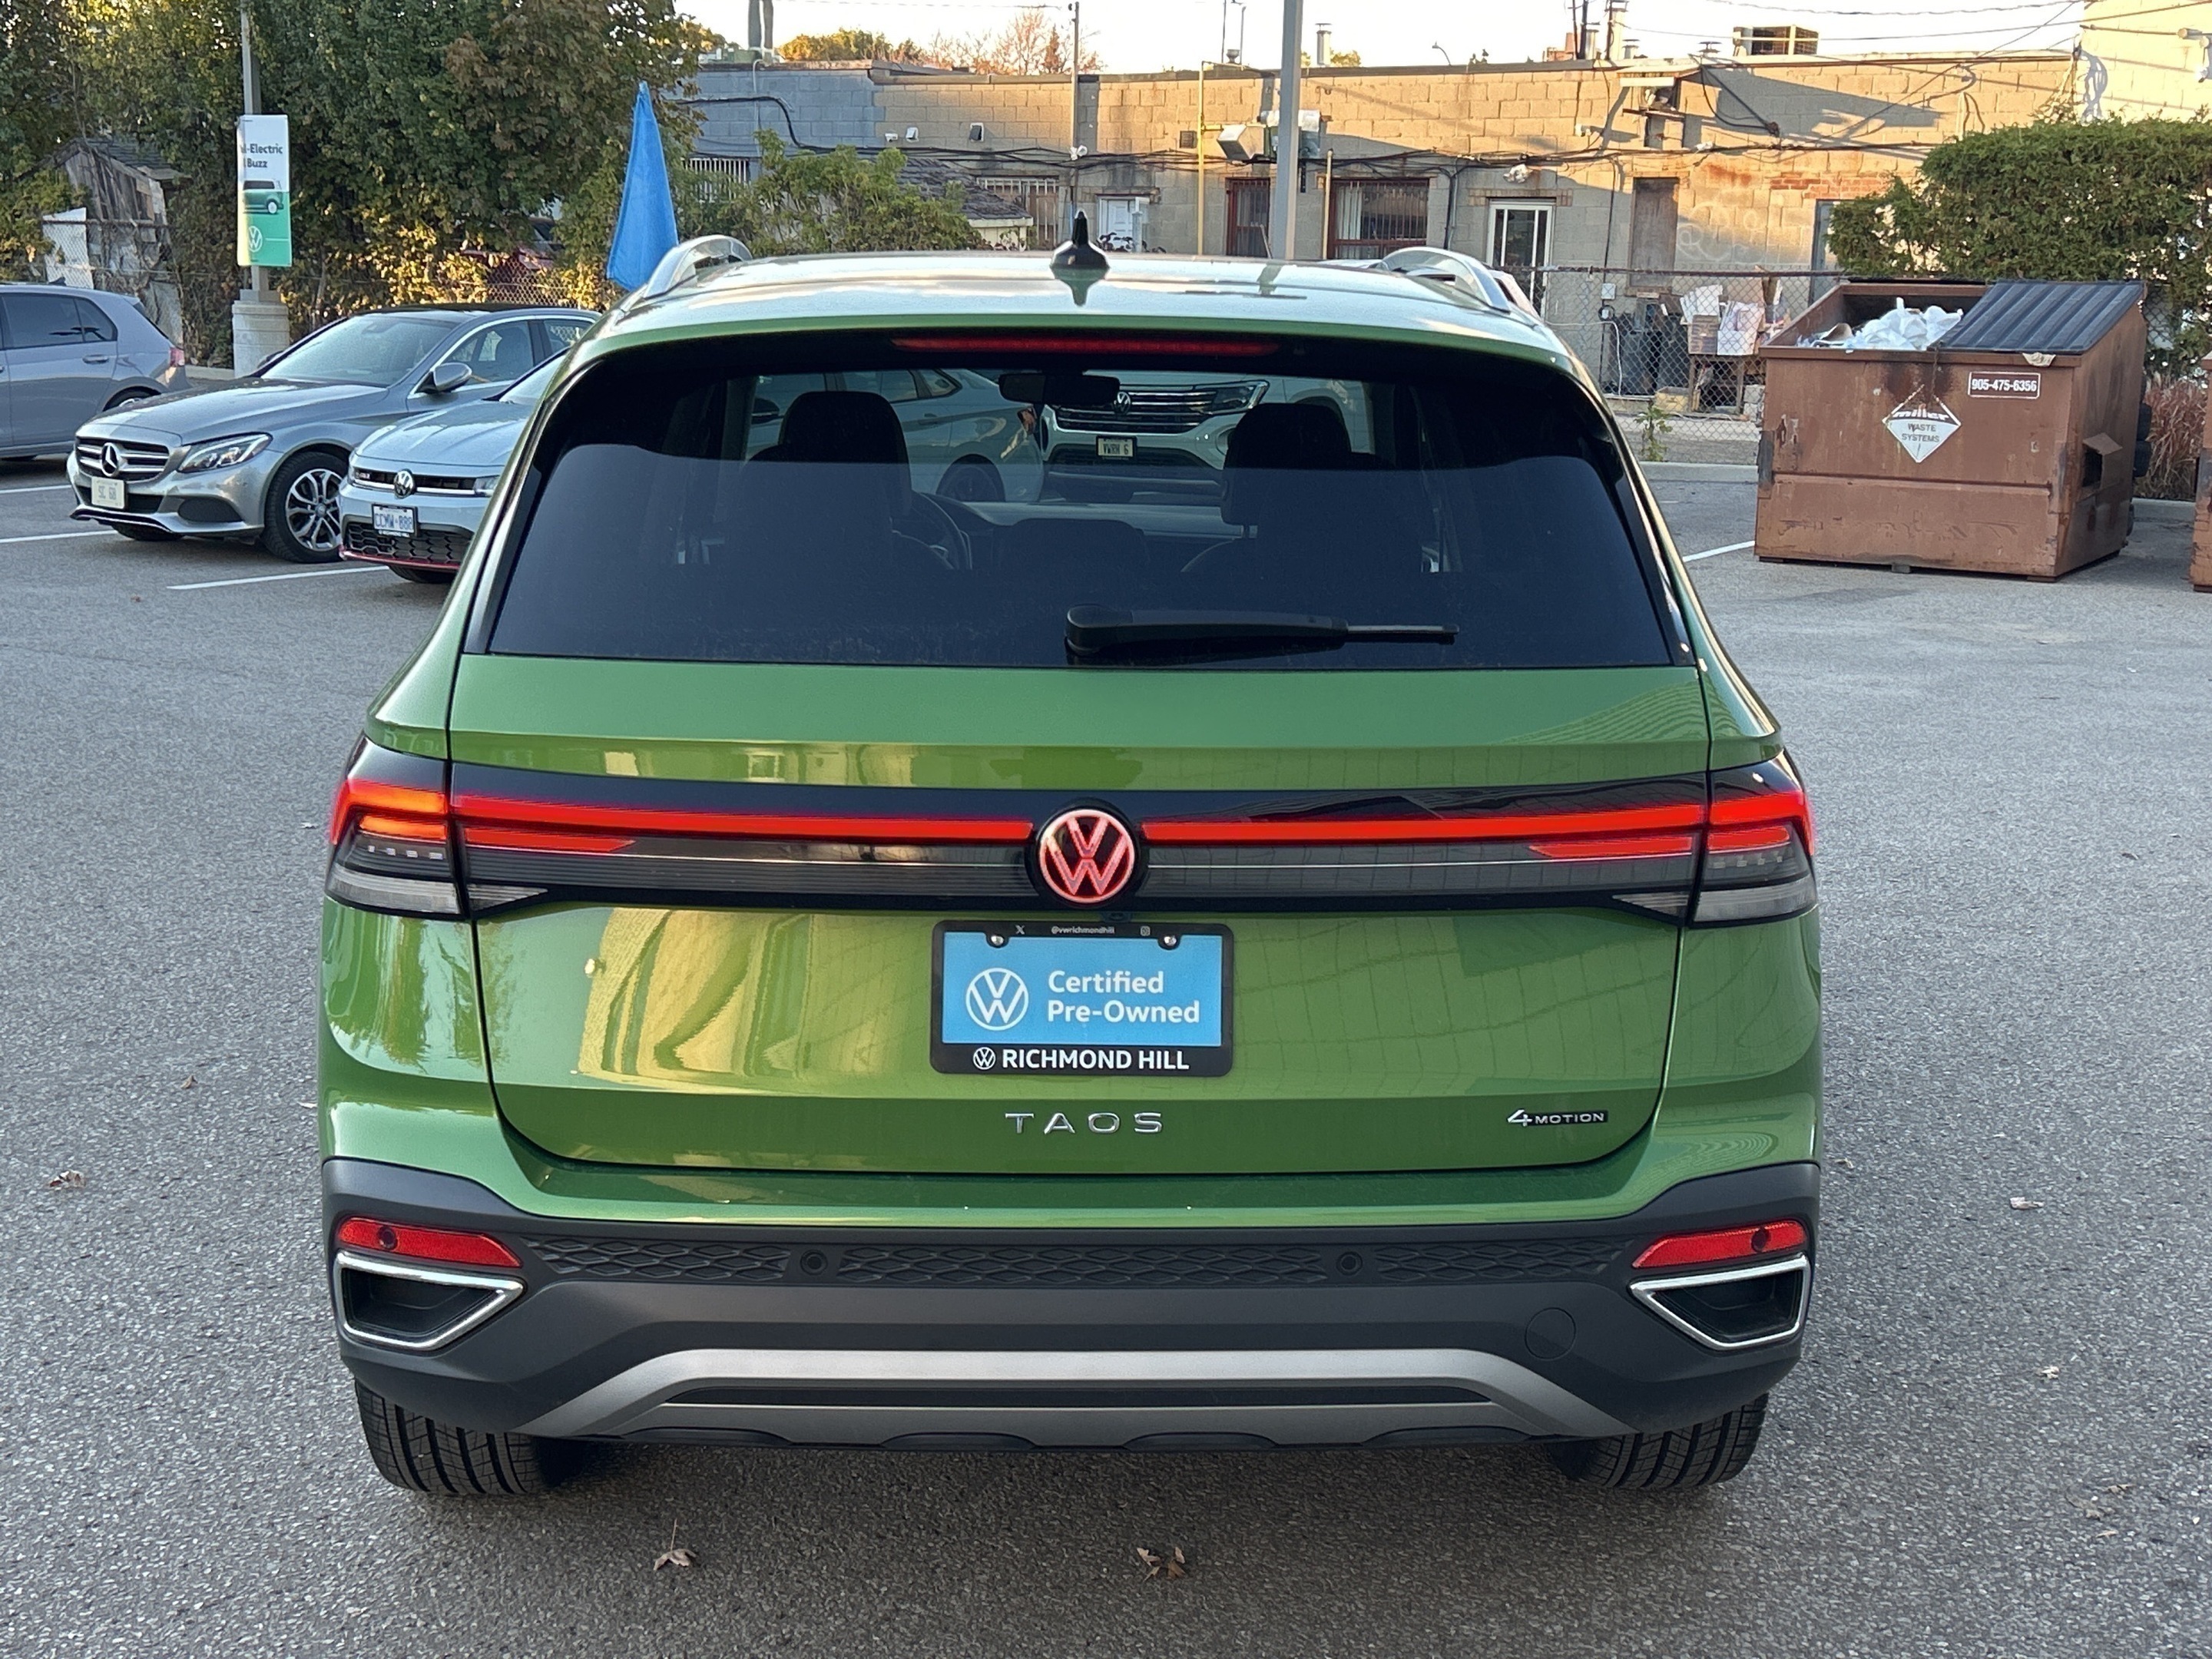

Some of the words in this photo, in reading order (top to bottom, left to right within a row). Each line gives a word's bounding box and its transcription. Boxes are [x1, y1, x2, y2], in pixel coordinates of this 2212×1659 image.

[247, 157, 268, 168] Buzz
[1971, 378, 2038, 392] 905-475-6356
[1907, 423, 1937, 432] WASTE
[1901, 433, 1940, 442] SYSTEMS
[1048, 970, 1164, 994] Certified
[1048, 999, 1200, 1024] Pre-Owned
[1002, 1048, 1132, 1070] RICHMOND
[1137, 1050, 1190, 1070] HILL
[1004, 1112, 1163, 1134] TAOS
[1507, 1109, 1605, 1127] 4MOTION
